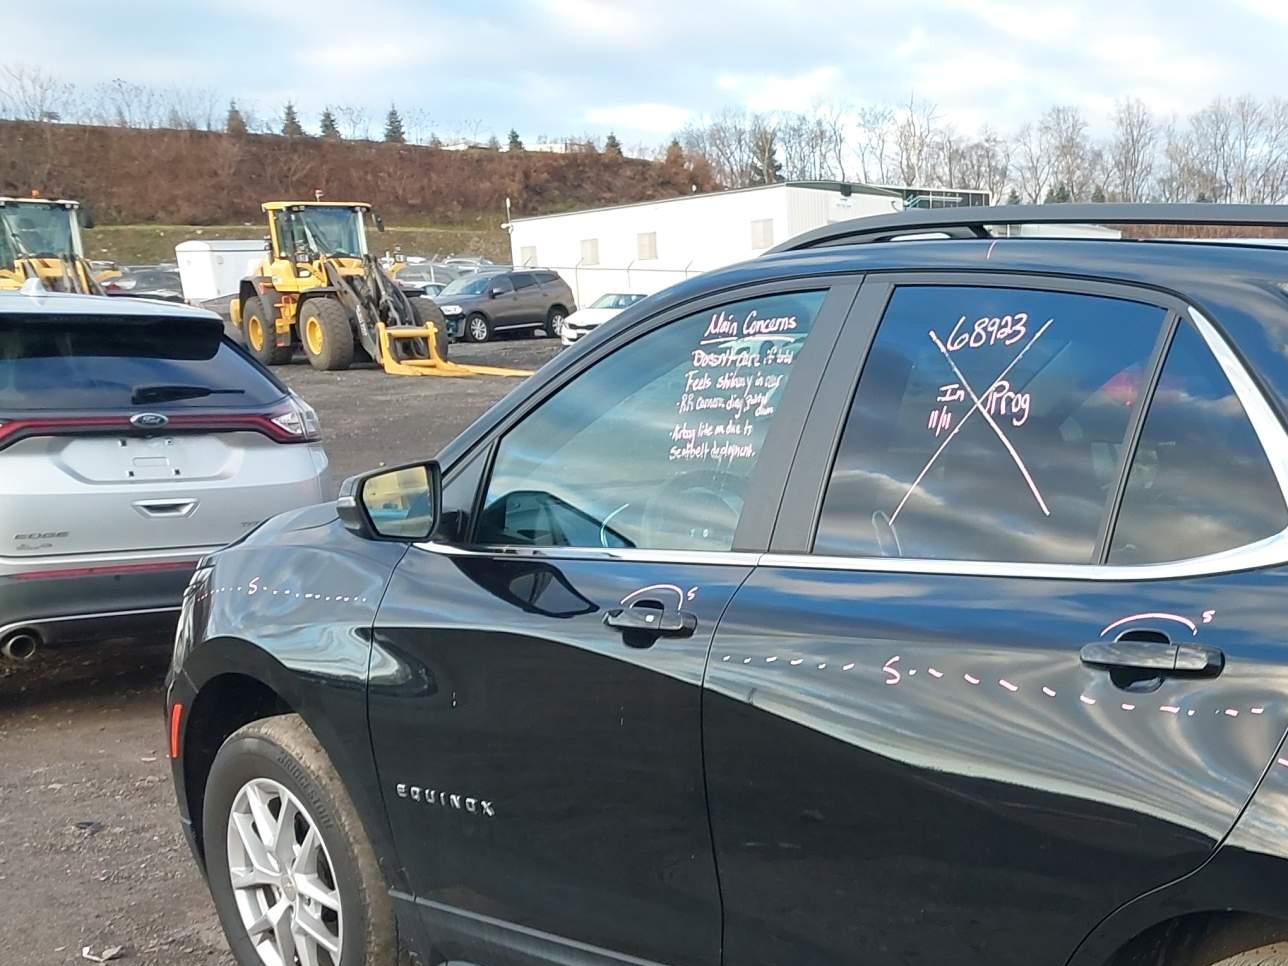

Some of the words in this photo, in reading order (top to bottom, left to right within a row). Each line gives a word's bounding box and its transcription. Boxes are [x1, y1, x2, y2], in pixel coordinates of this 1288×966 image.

[704, 311, 738, 337] Main
[742, 310, 797, 334] Concerns
[946, 313, 1028, 351] 68923
[936, 383, 965, 402] In
[14, 531, 70, 541] EDGE
[396, 783, 496, 817] EQUINOX
